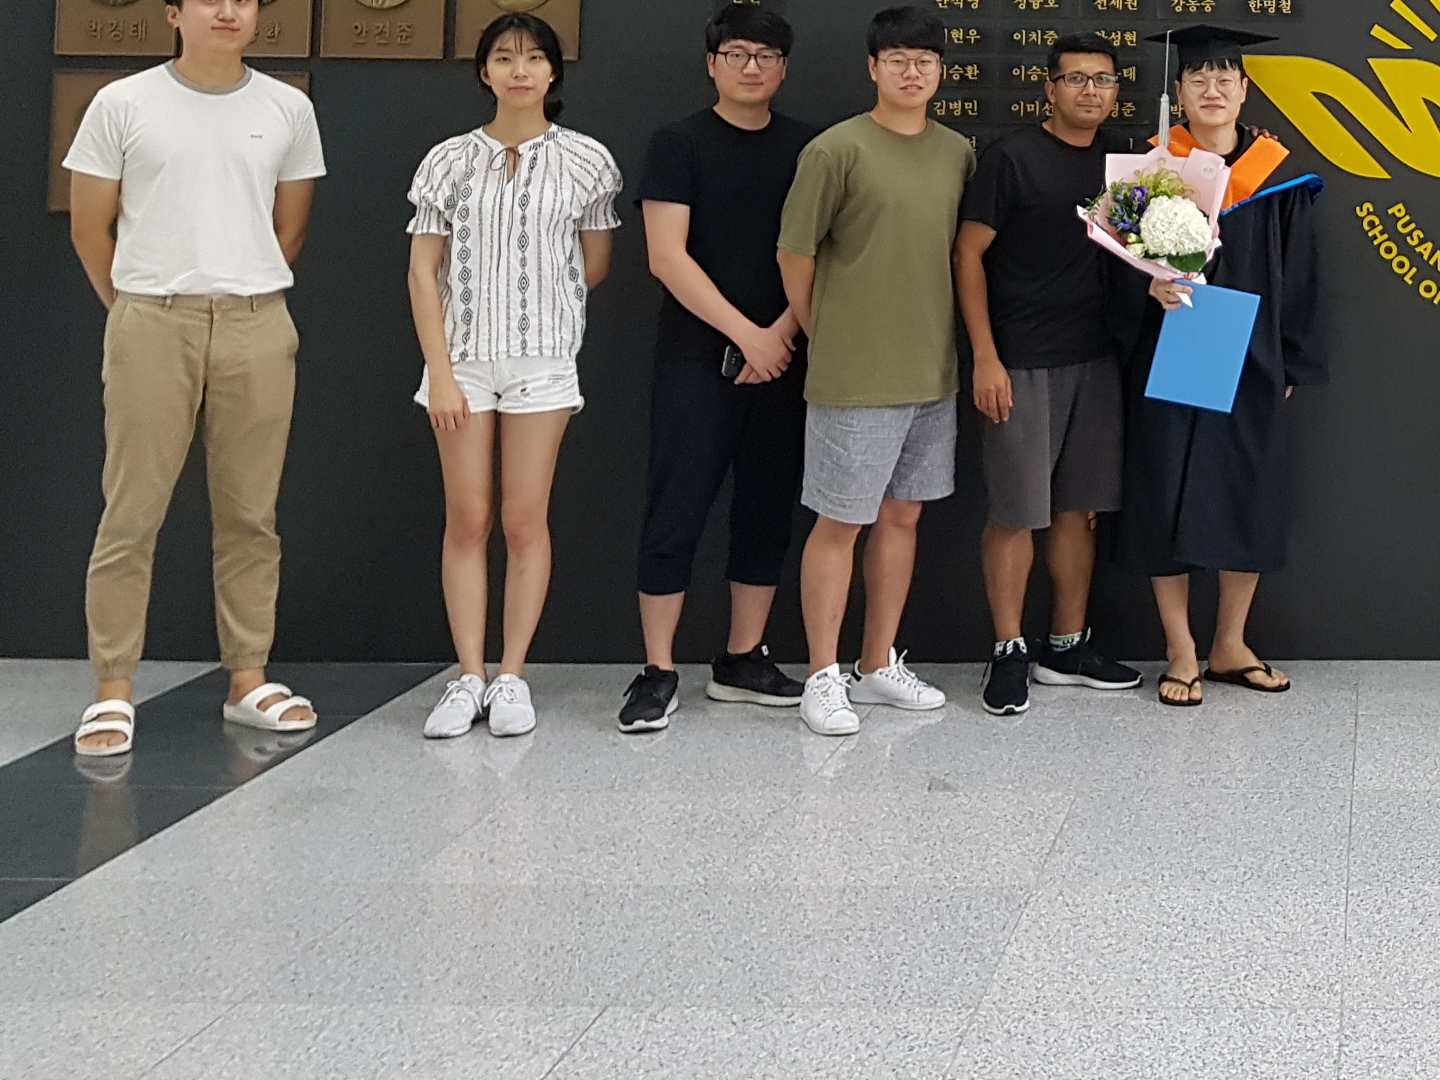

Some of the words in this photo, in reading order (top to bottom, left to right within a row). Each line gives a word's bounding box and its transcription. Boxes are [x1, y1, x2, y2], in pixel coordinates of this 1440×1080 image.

[943, 28, 981, 44] 현우
[941, 65, 979, 80] 승환
[933, 100, 978, 116] 김병민
[1355, 202, 1418, 285] SCHOOL
